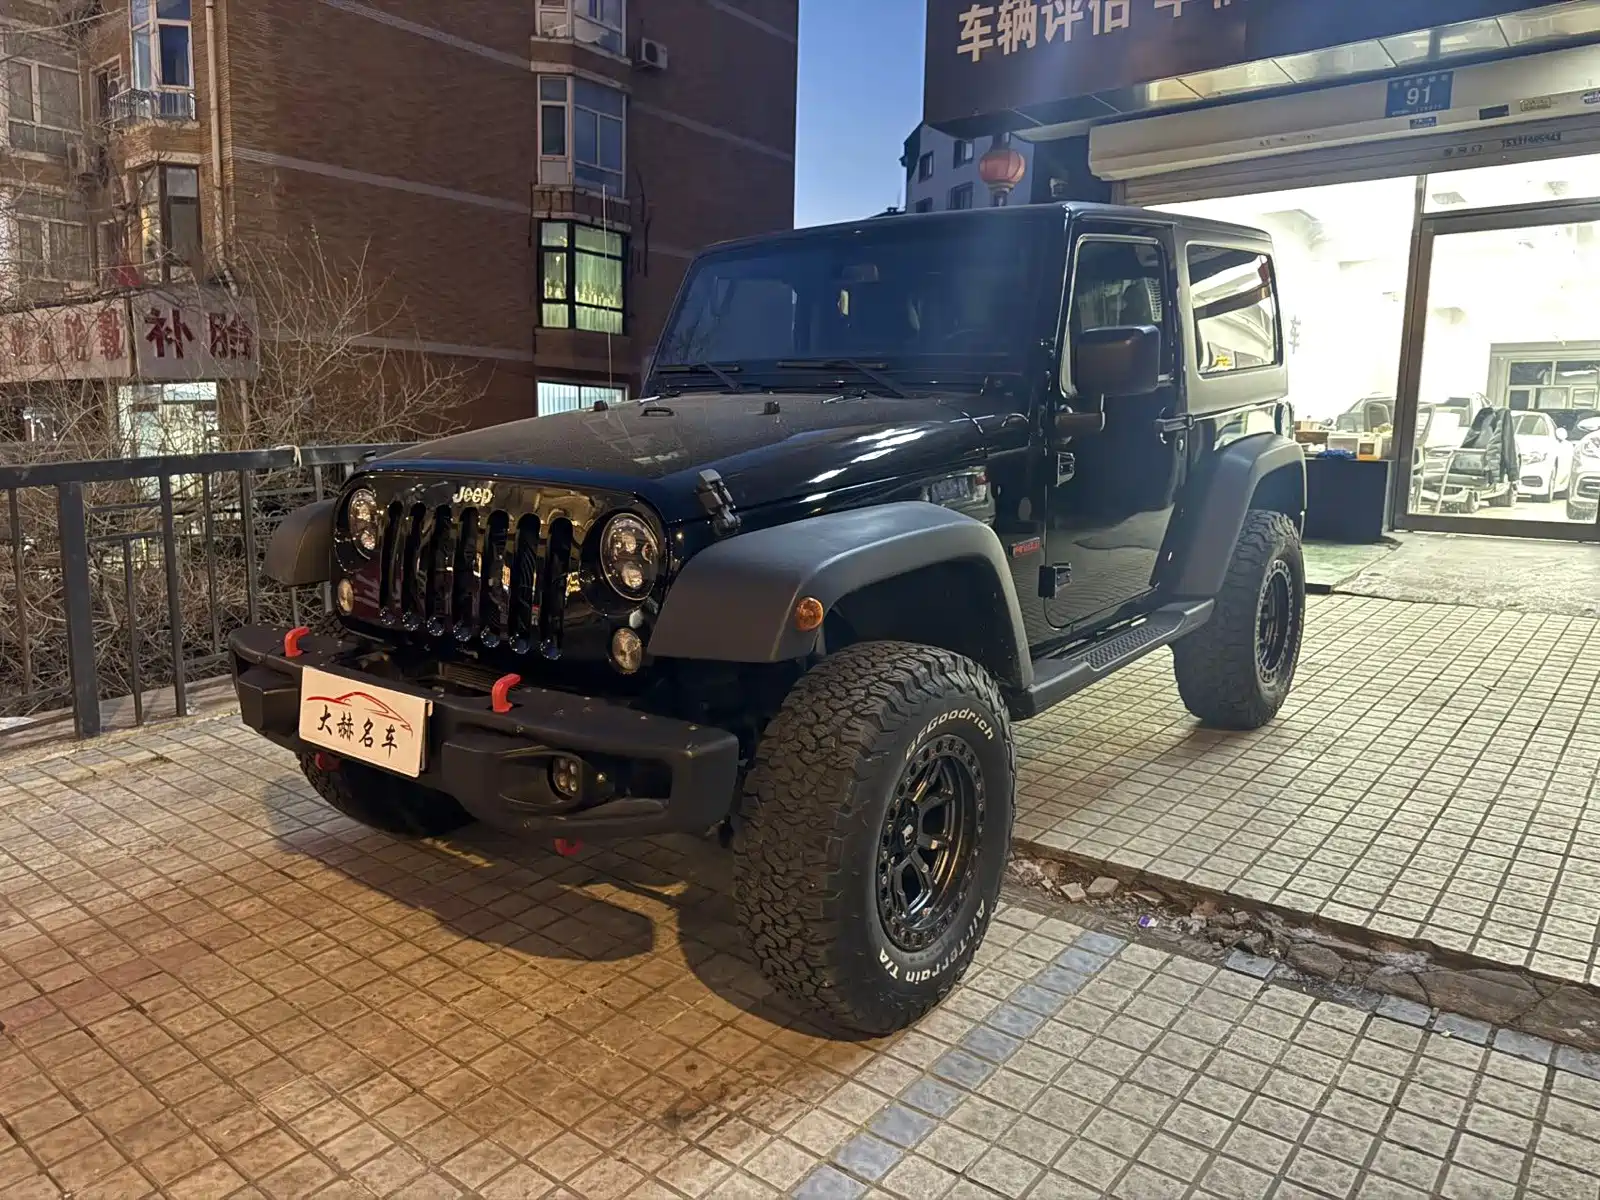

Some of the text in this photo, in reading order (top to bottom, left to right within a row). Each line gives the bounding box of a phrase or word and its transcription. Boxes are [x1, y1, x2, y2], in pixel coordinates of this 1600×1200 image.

[1406, 84, 1431, 105] 91
[452, 486, 493, 506] Jeep
[317, 704, 398, 759] 大赫名车
[905, 708, 994, 761] BFGoodrich
